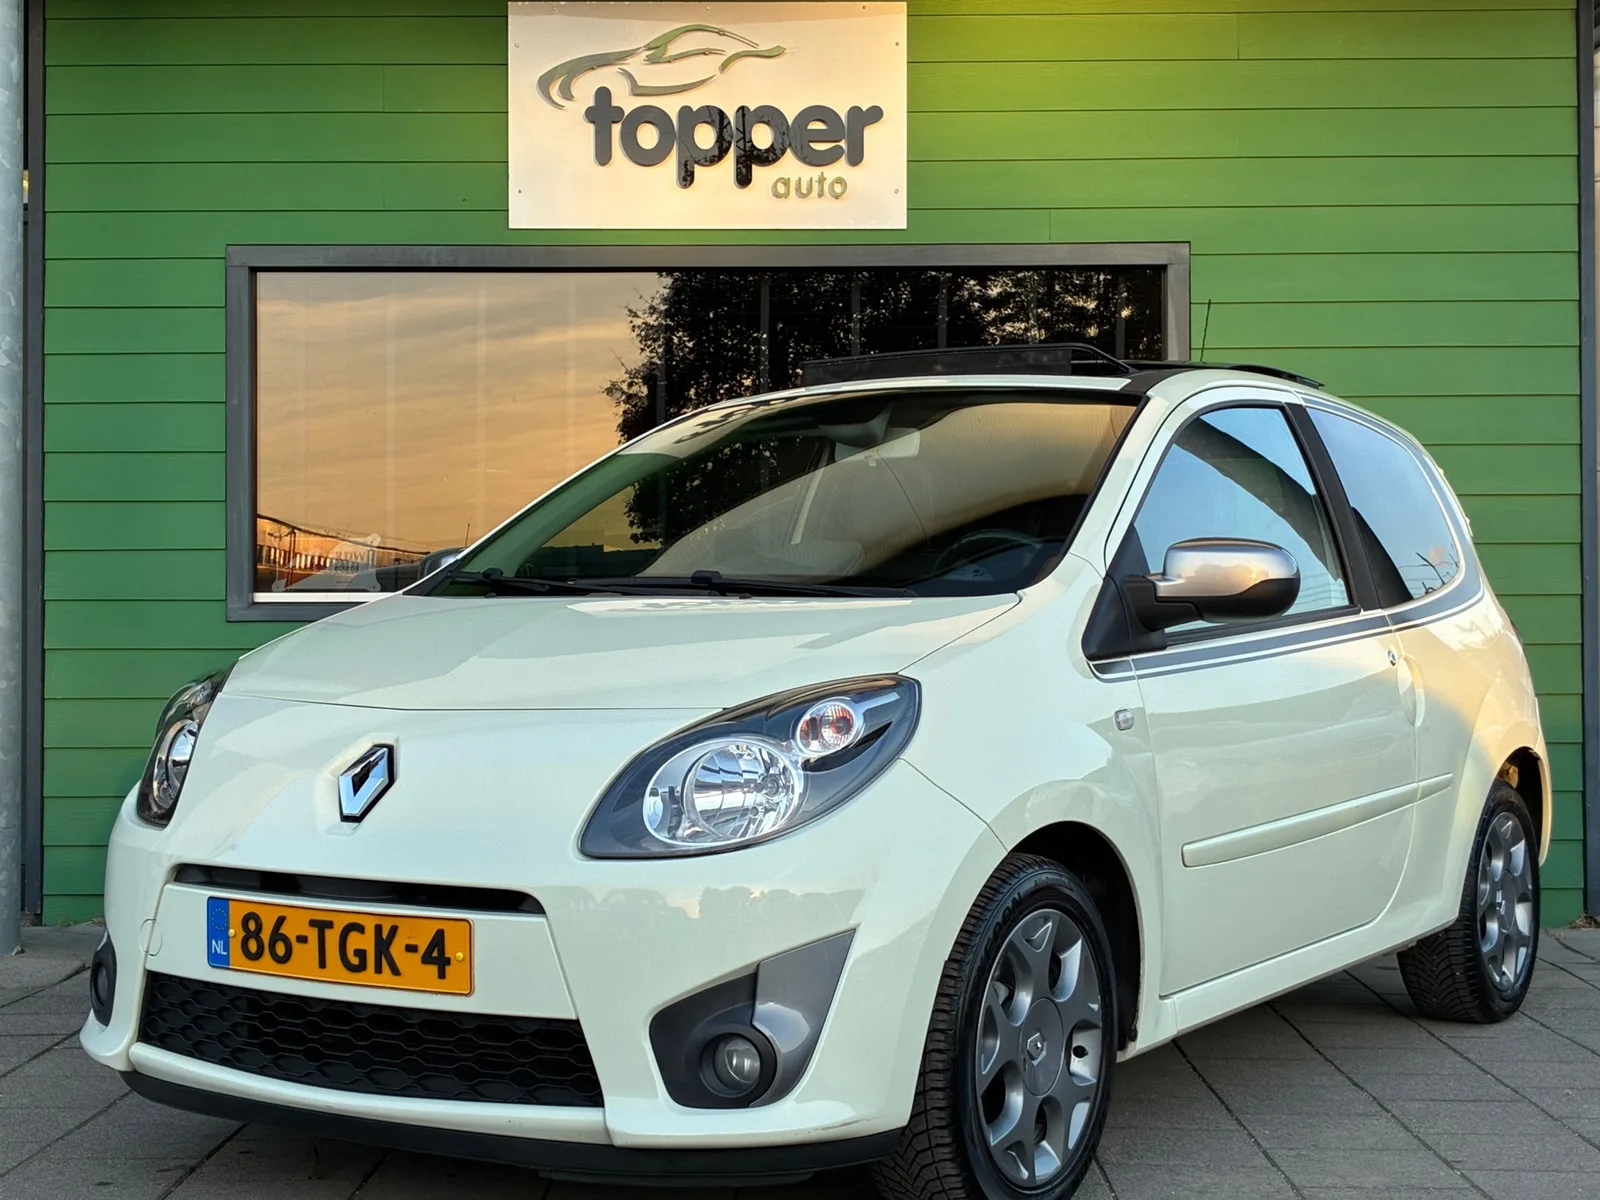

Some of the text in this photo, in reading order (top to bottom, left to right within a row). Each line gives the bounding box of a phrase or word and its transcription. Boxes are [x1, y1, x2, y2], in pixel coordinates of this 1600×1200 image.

[584, 86, 884, 189] topper
[771, 171, 848, 200] auto
[334, 562, 360, 571] erkend
[335, 550, 366, 561] RDW
[211, 938, 228, 956] NL
[240, 911, 452, 980] 86-TGK-4
